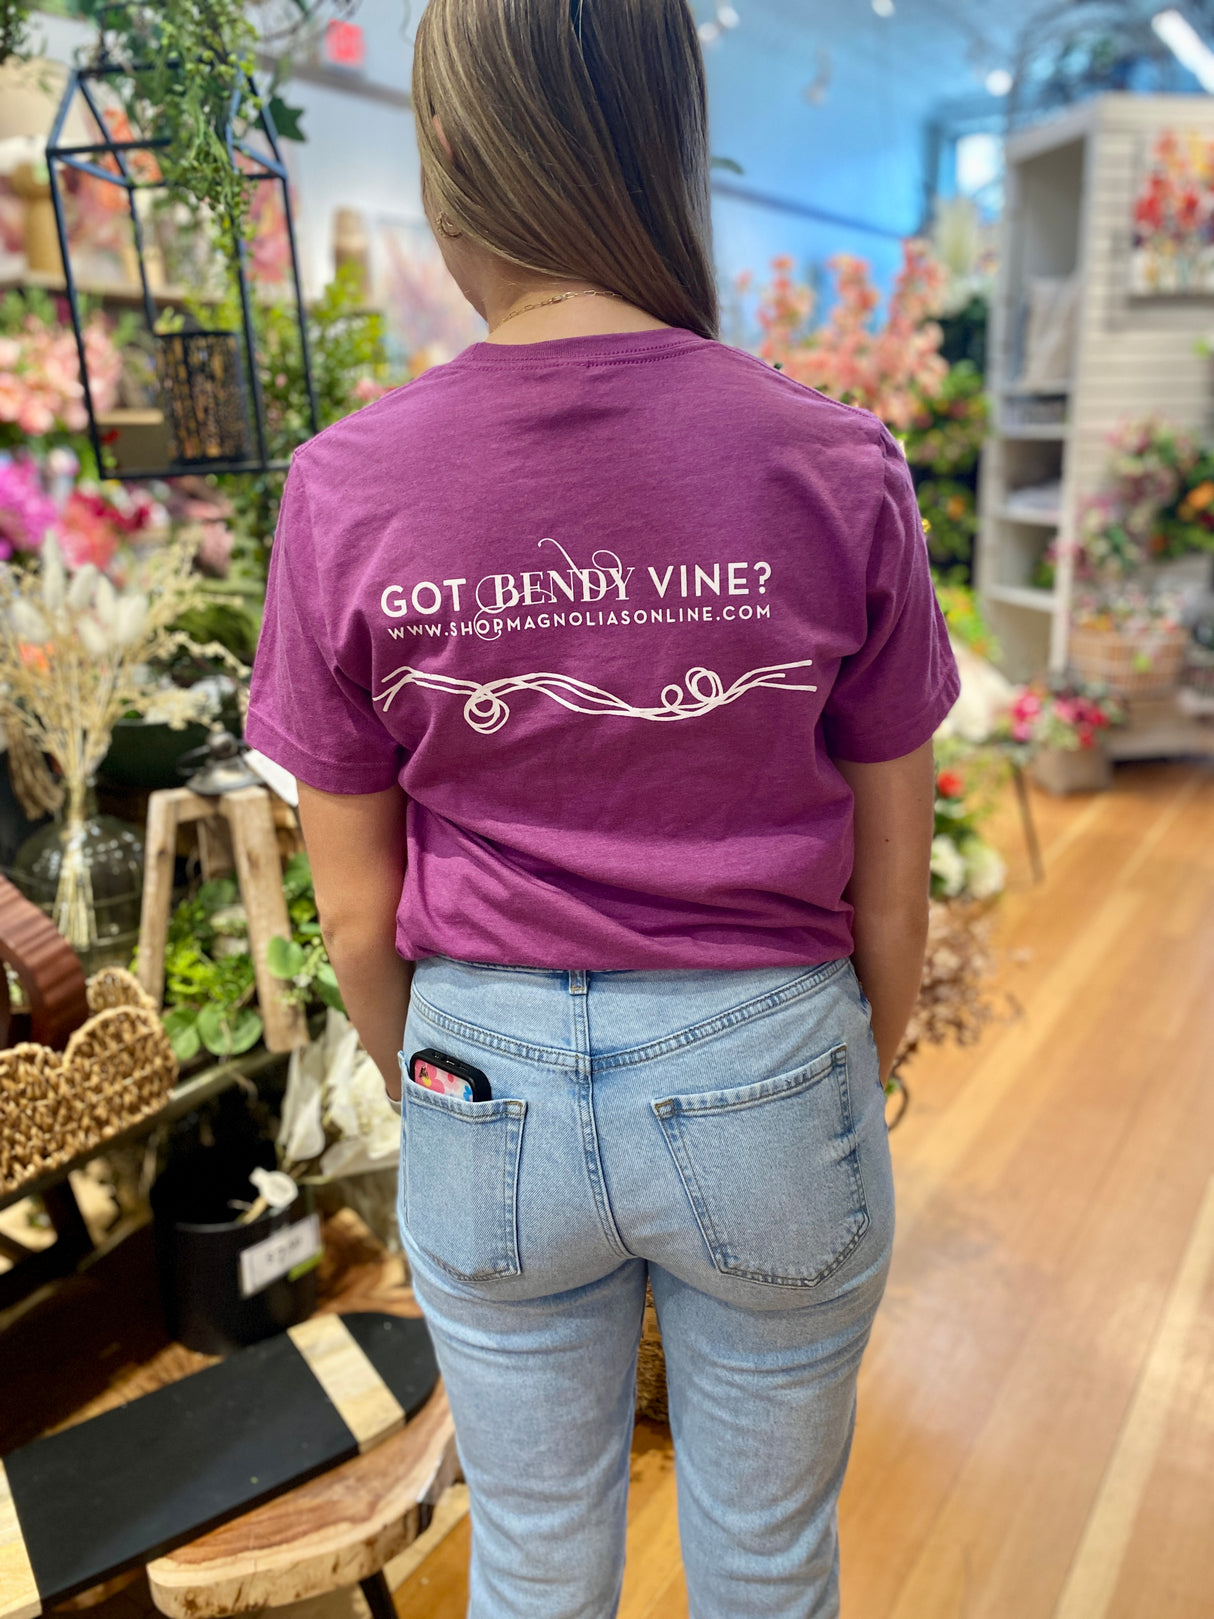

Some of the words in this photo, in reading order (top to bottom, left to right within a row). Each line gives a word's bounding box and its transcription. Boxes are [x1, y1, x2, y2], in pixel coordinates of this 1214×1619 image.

[380, 578, 467, 618] GOT
[647, 561, 773, 599] VINE?
[387, 604, 772, 641] WWW.SHOPMAGNOLIASONLINE.COM
